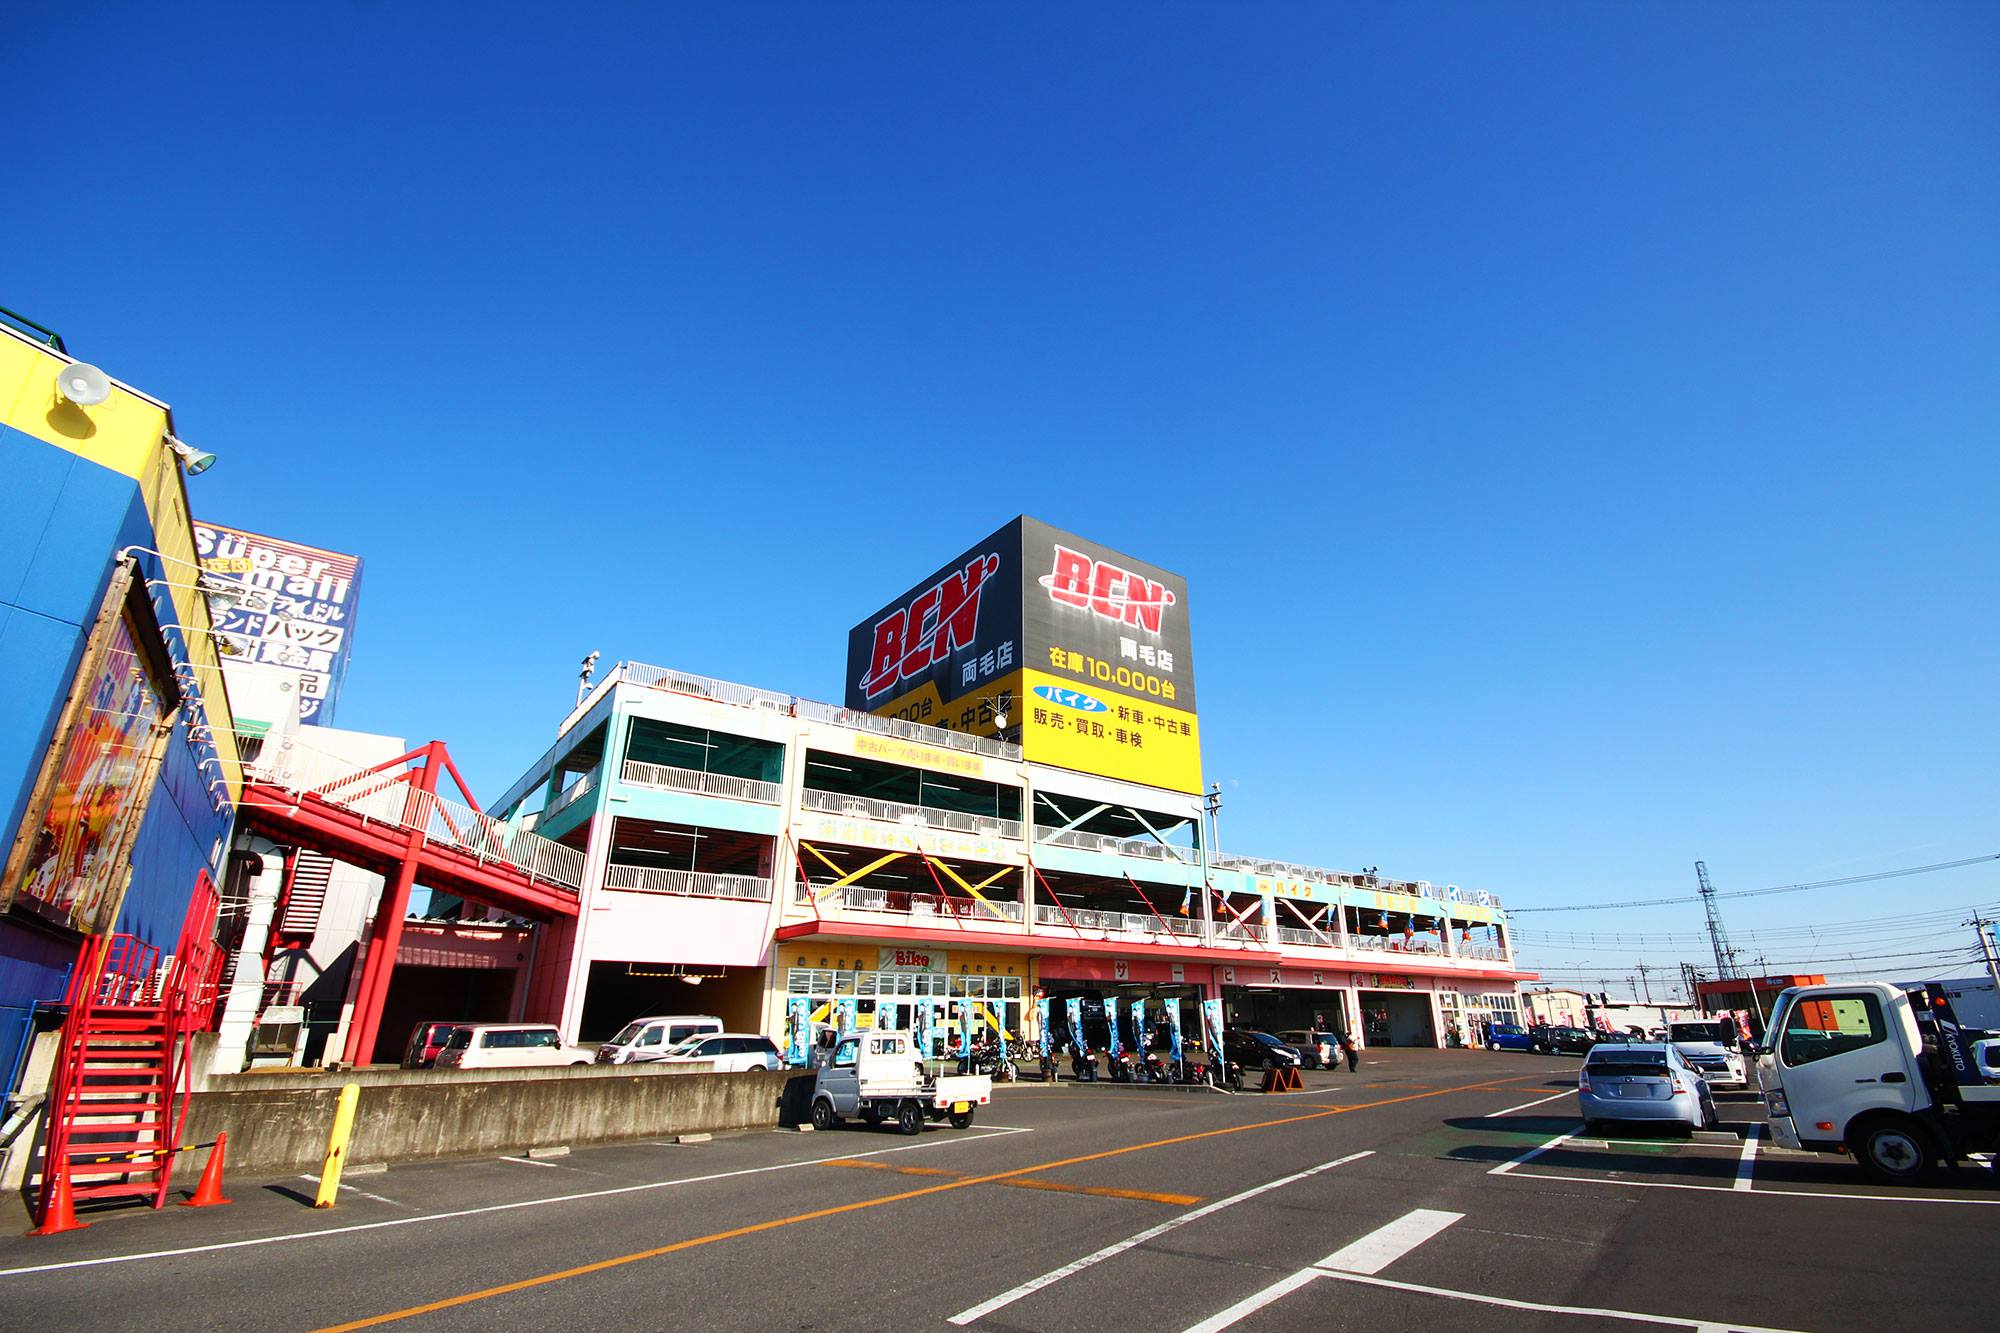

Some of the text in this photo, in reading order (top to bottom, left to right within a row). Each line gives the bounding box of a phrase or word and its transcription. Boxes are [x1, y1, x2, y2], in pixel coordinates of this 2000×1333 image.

[242, 567, 351, 605] mall
[962, 640, 1013, 687] 両毛店
[1049, 647, 1176, 700] 在庫10,000台
[1120, 636, 1174, 673] 両毛店
[1944, 1033, 1966, 1071] KYOKUTO
